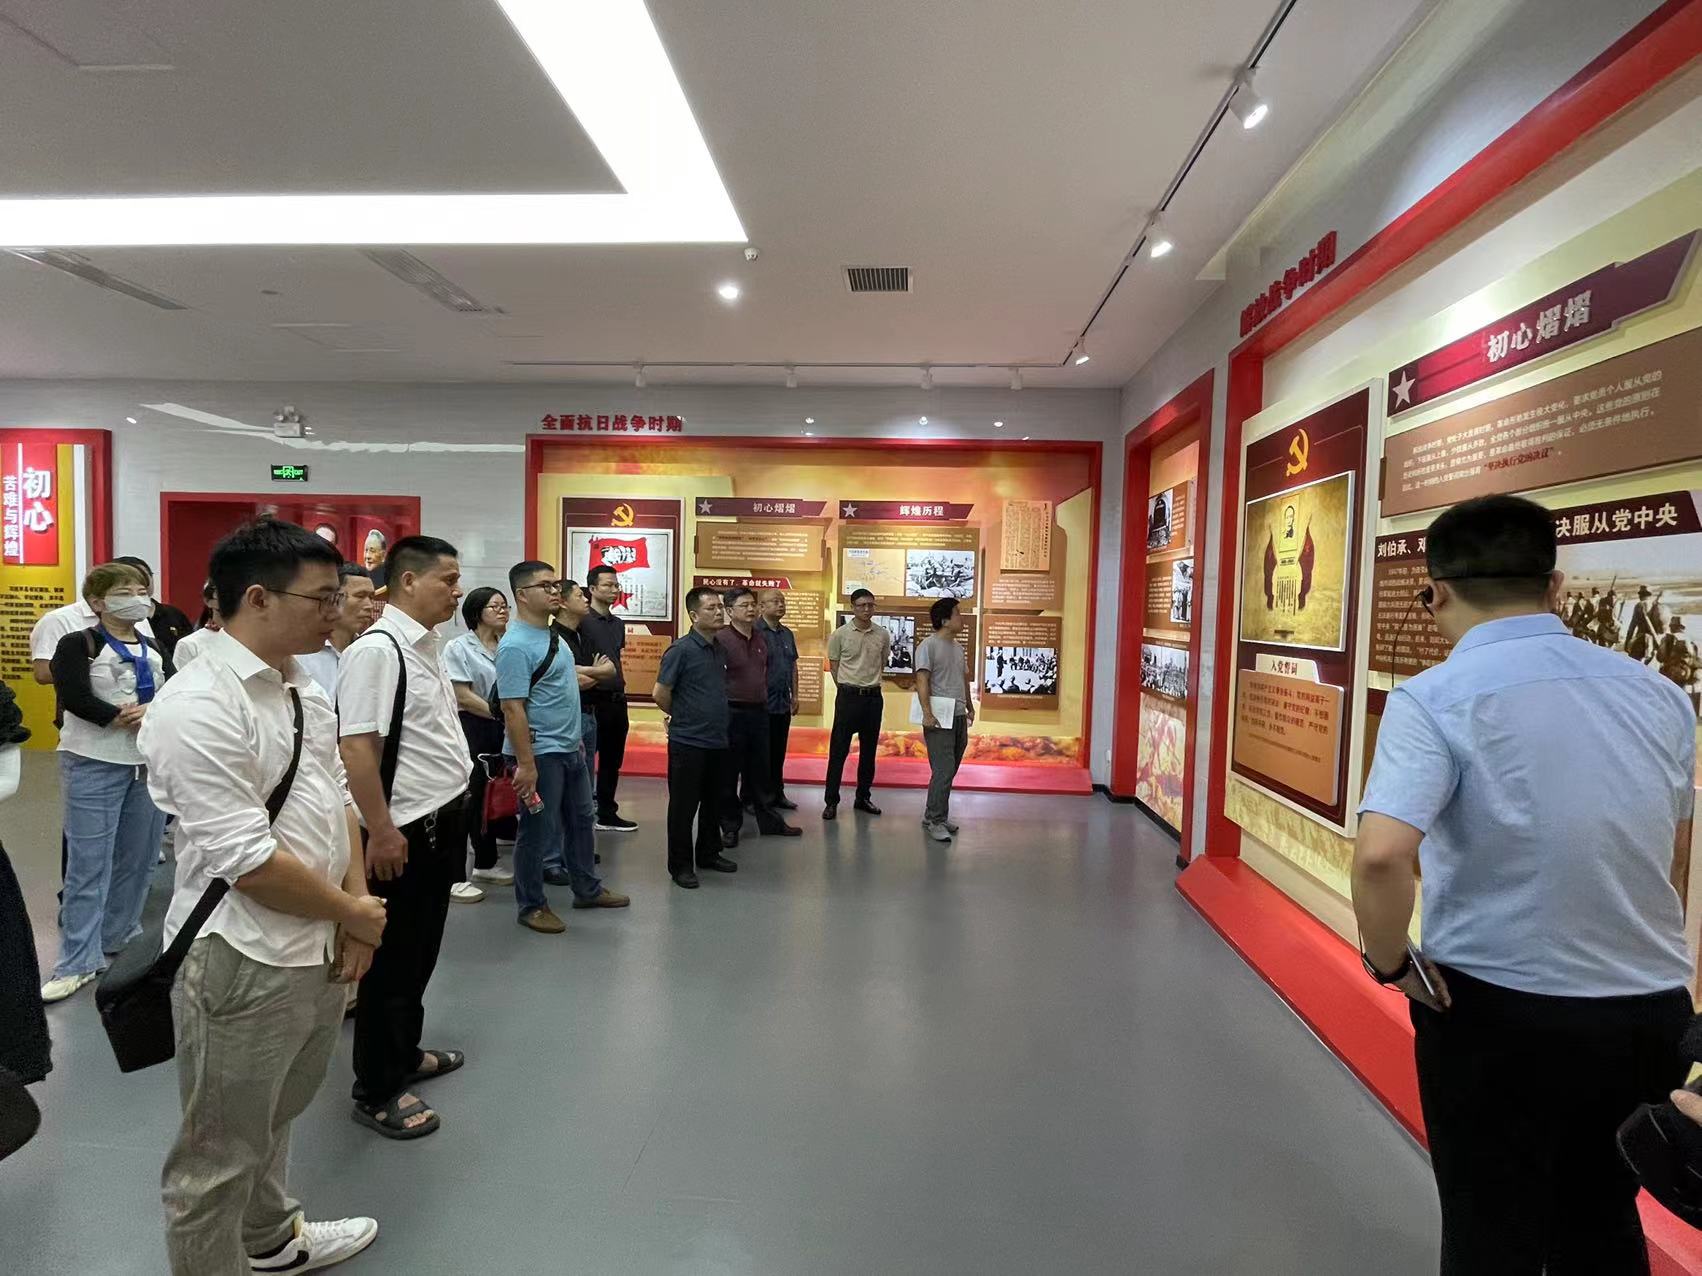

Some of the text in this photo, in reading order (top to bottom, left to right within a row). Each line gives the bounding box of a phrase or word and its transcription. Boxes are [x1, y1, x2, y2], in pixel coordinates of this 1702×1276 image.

[1486, 290, 1593, 363] 初心熠熠
[541, 414, 683, 433] 全面抗日战争时期
[23, 467, 55, 533] 初心
[753, 502, 796, 514] 初心熠熠
[899, 505, 945, 517] 辉煌历程
[1555, 502, 1679, 538] 决服从党中央
[1270, 659, 1298, 676] 入党誓词
